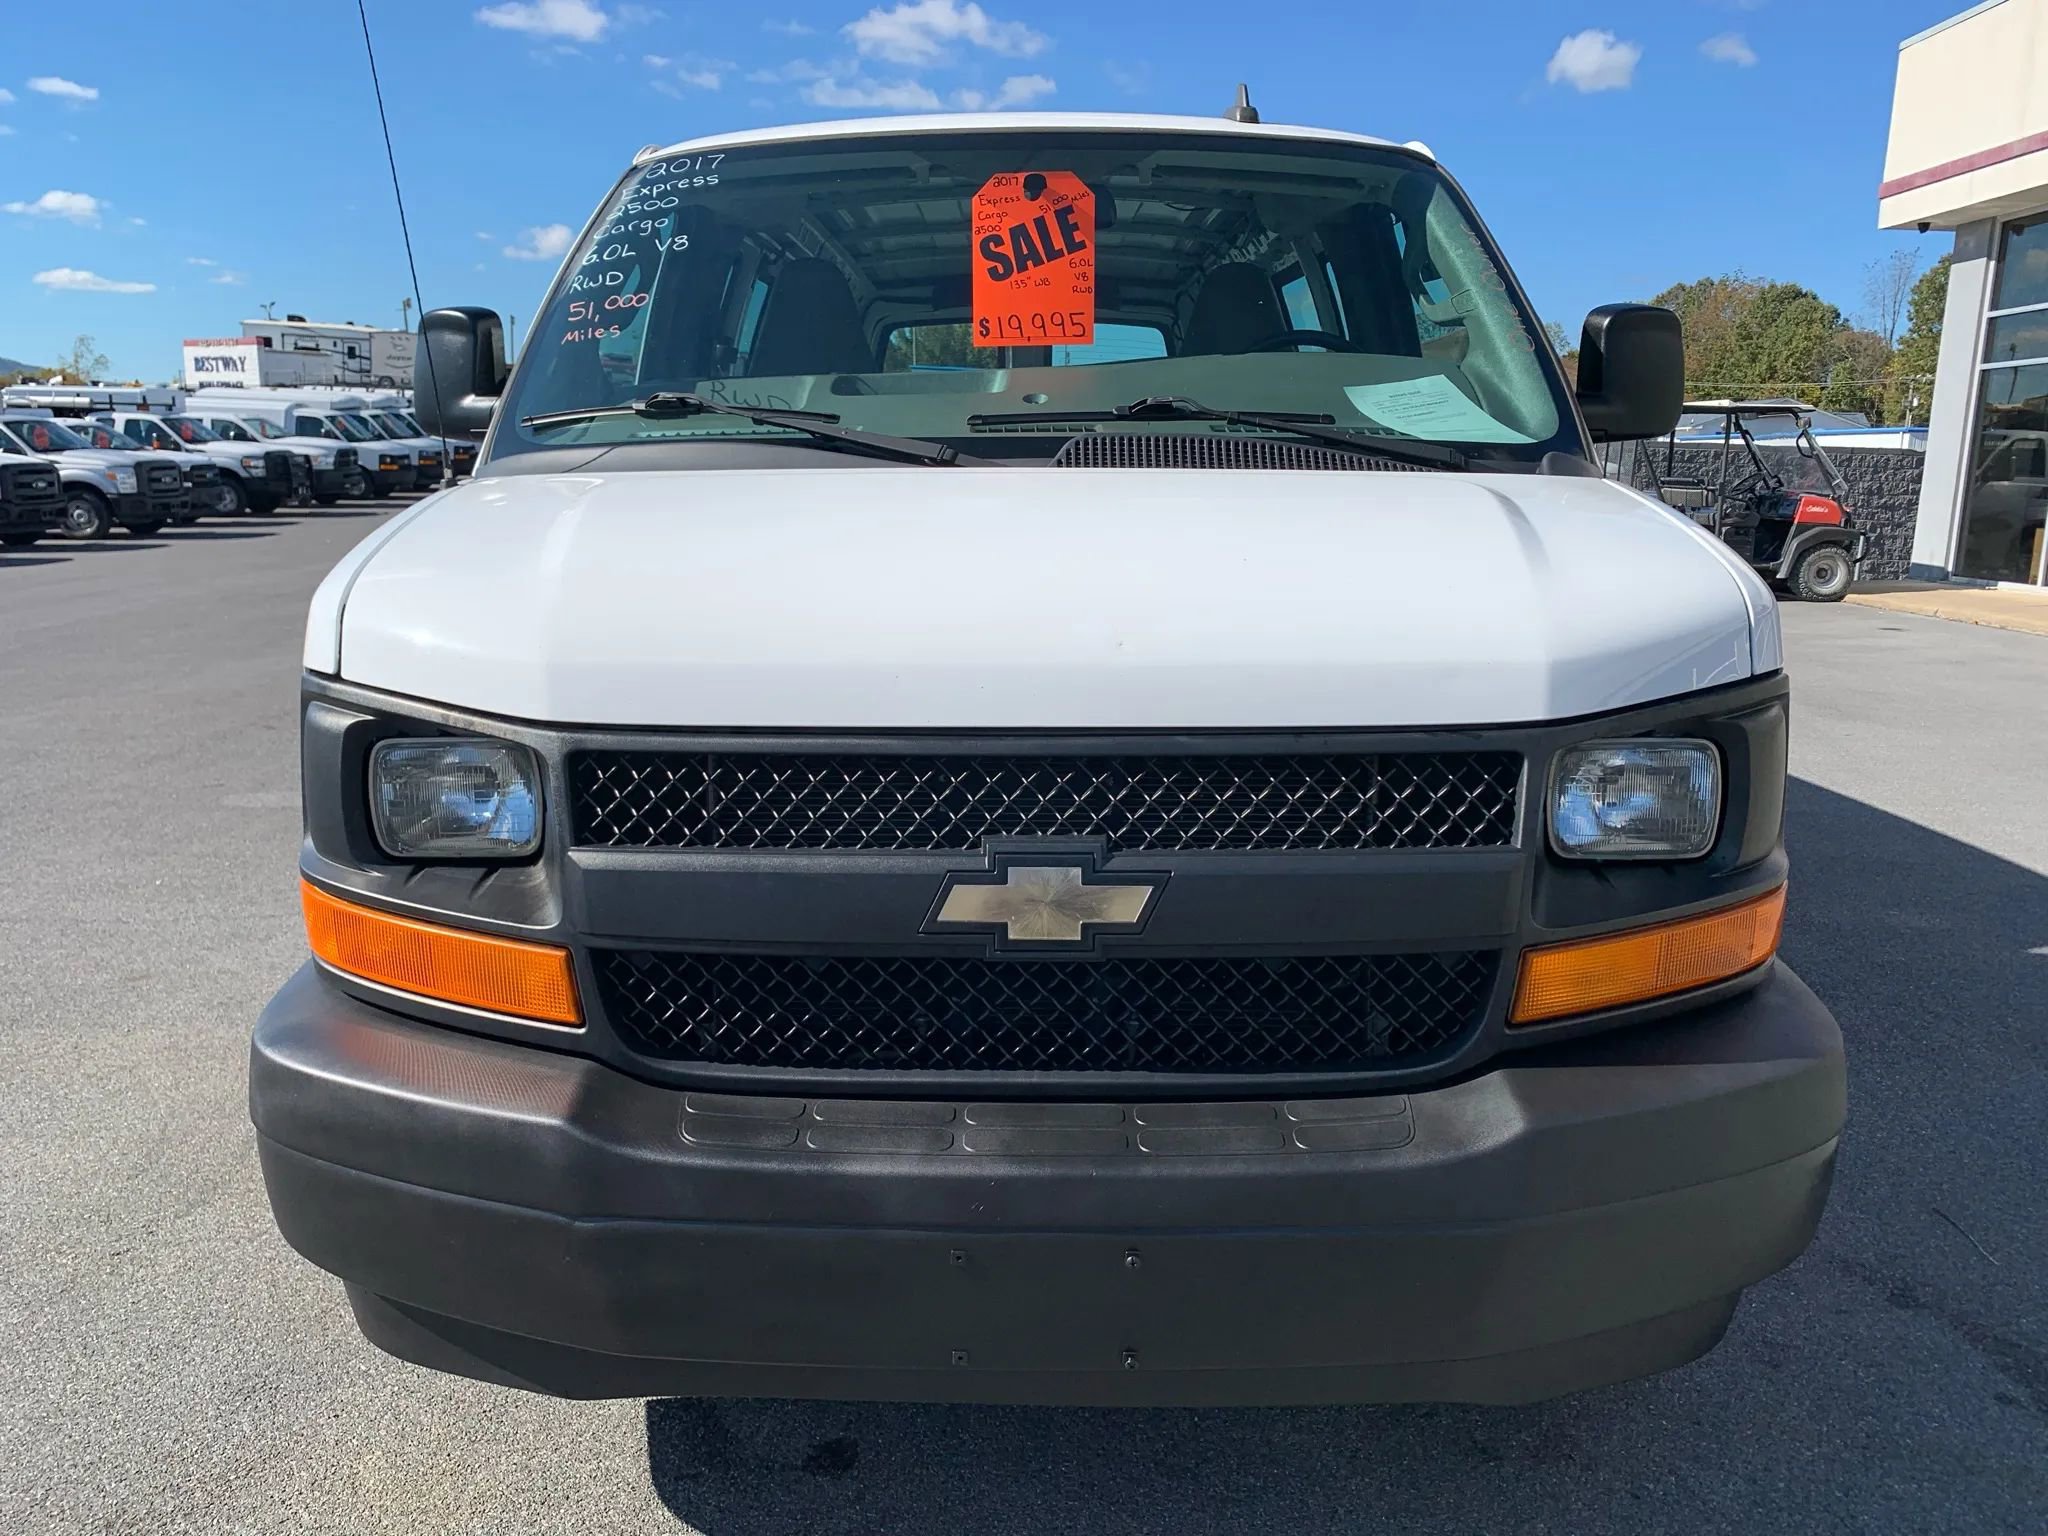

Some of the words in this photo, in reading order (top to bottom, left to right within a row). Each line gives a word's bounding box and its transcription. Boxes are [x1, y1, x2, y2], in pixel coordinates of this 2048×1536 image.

[646, 154, 725, 178] 2017
[622, 174, 719, 200] Express
[993, 177, 1019, 188] 2017
[606, 197, 679, 220] 2500
[978, 194, 1021, 208] Express
[978, 211, 1008, 224] Cargo
[974, 225, 1002, 236] 2500
[582, 243, 637, 265] 6.0L
[654, 235, 689, 252] V8
[979, 205, 1088, 282] SALE
[1069, 257, 1094, 269] 6.0L
[569, 271, 624, 294] RWD
[1074, 271, 1089, 282] V8
[1072, 285, 1094, 295] RWD
[568, 293, 649, 322] 51,000
[561, 324, 621, 345] Miles
